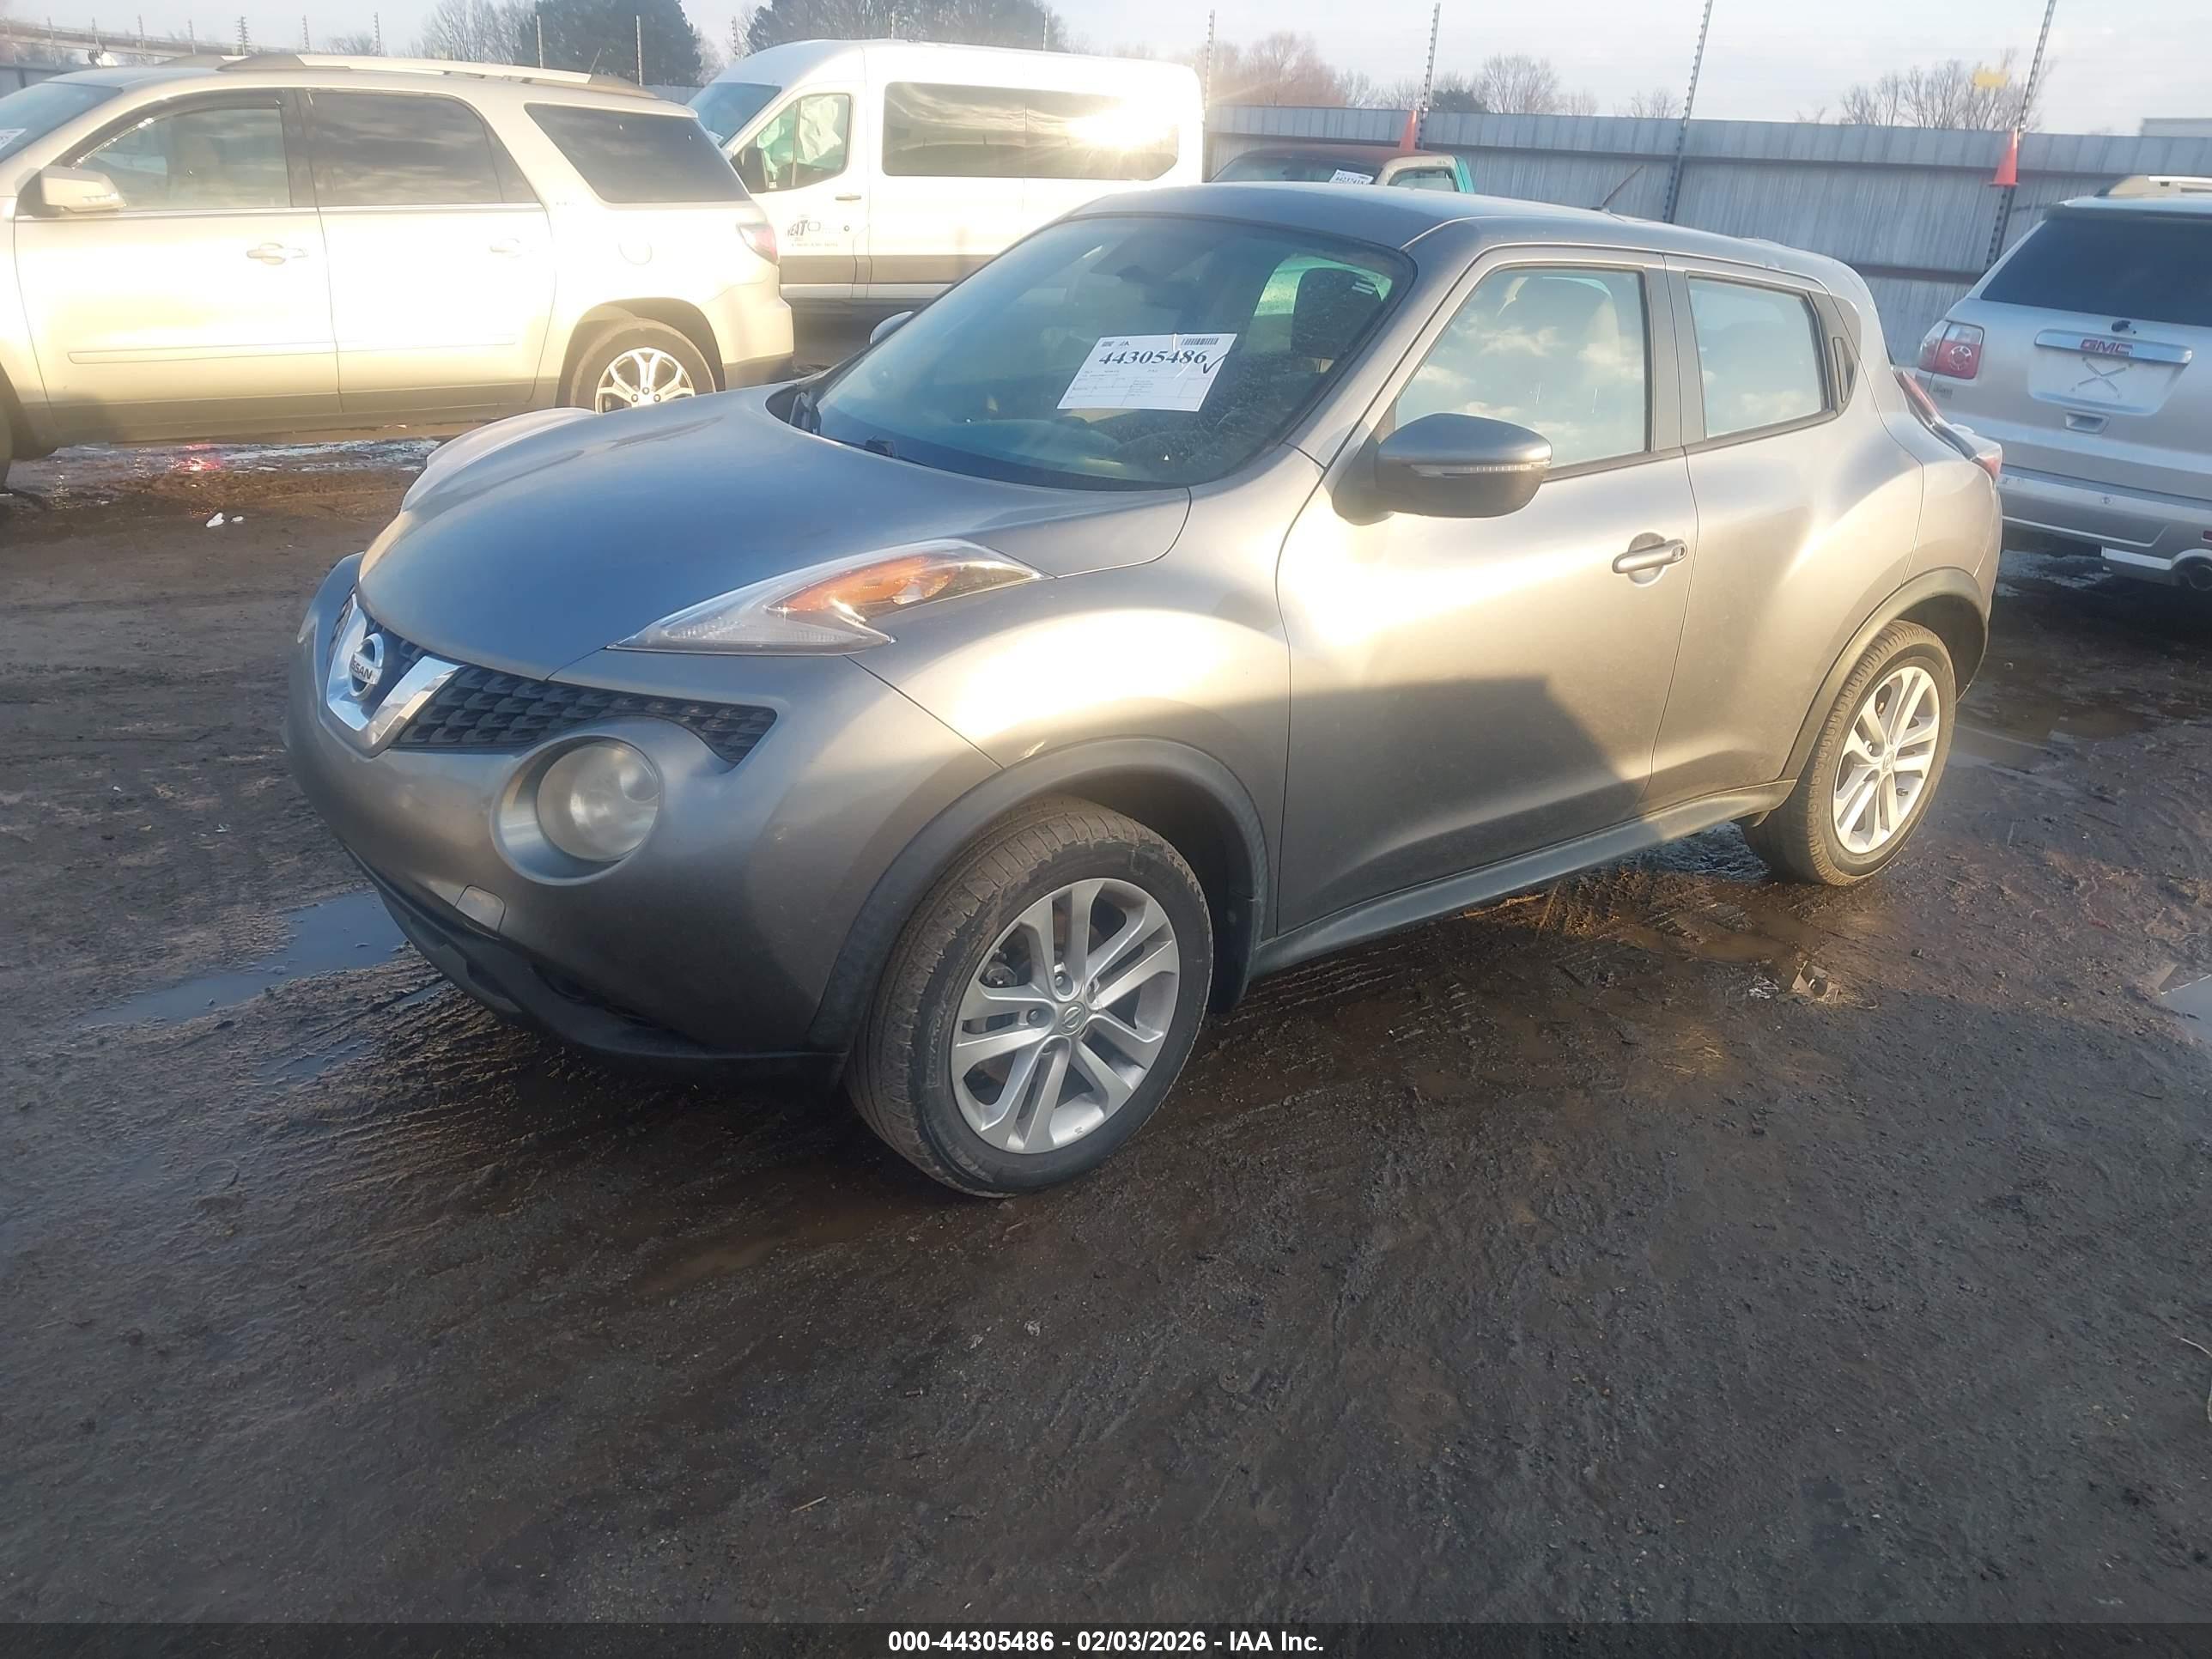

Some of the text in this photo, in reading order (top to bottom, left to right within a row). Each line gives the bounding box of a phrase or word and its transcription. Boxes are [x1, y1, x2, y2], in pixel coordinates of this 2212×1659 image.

[2080, 339, 2134, 356] GMC
[1099, 350, 1209, 365] 44305486
[350, 660, 373, 679] SSAN
